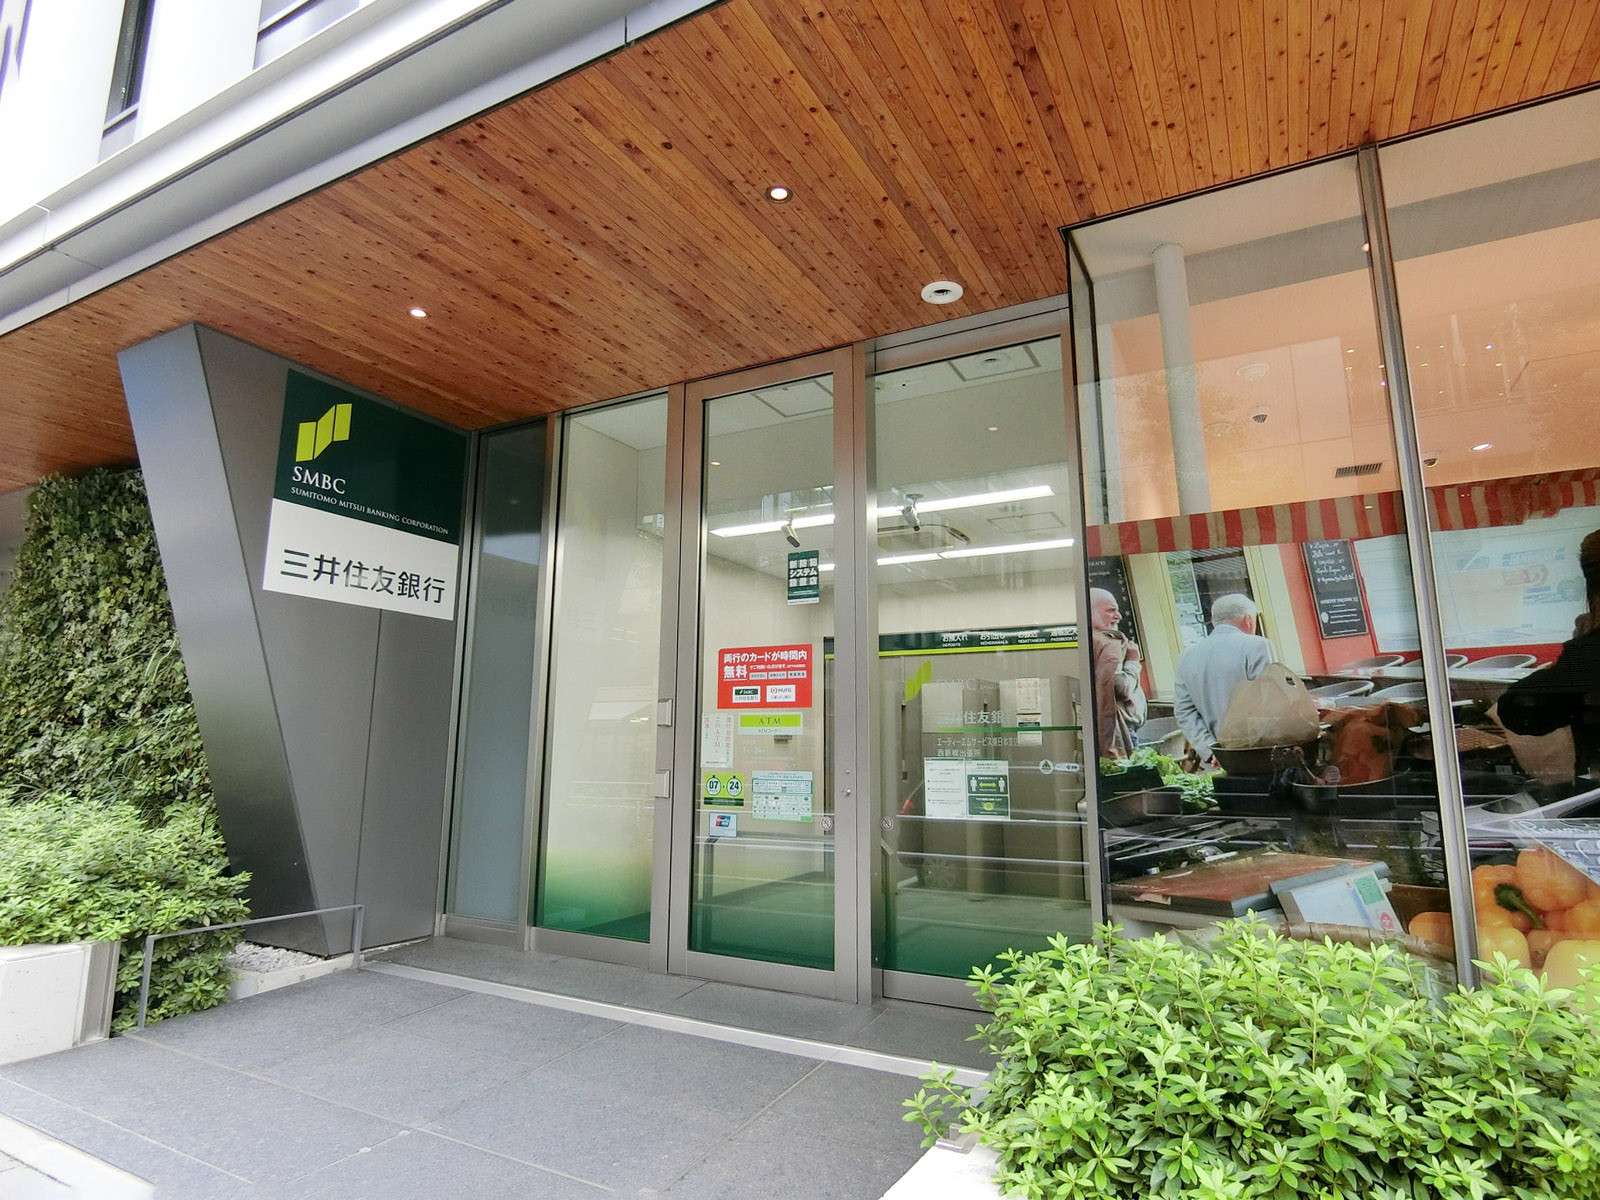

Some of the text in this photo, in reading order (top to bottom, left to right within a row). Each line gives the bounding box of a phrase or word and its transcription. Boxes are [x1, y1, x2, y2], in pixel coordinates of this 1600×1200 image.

[292, 466, 347, 495] SMBC
[291, 486, 449, 535] SUMITOMO MITSUI BANKING CORPORATION
[281, 549, 446, 604] 三井住友銀行
[789, 567, 818, 578] システム
[723, 650, 808, 663] 両行のカードが時間内
[723, 665, 748, 678] 無料
[758, 717, 781, 725] ATM
[709, 781, 739, 790] 07 24
